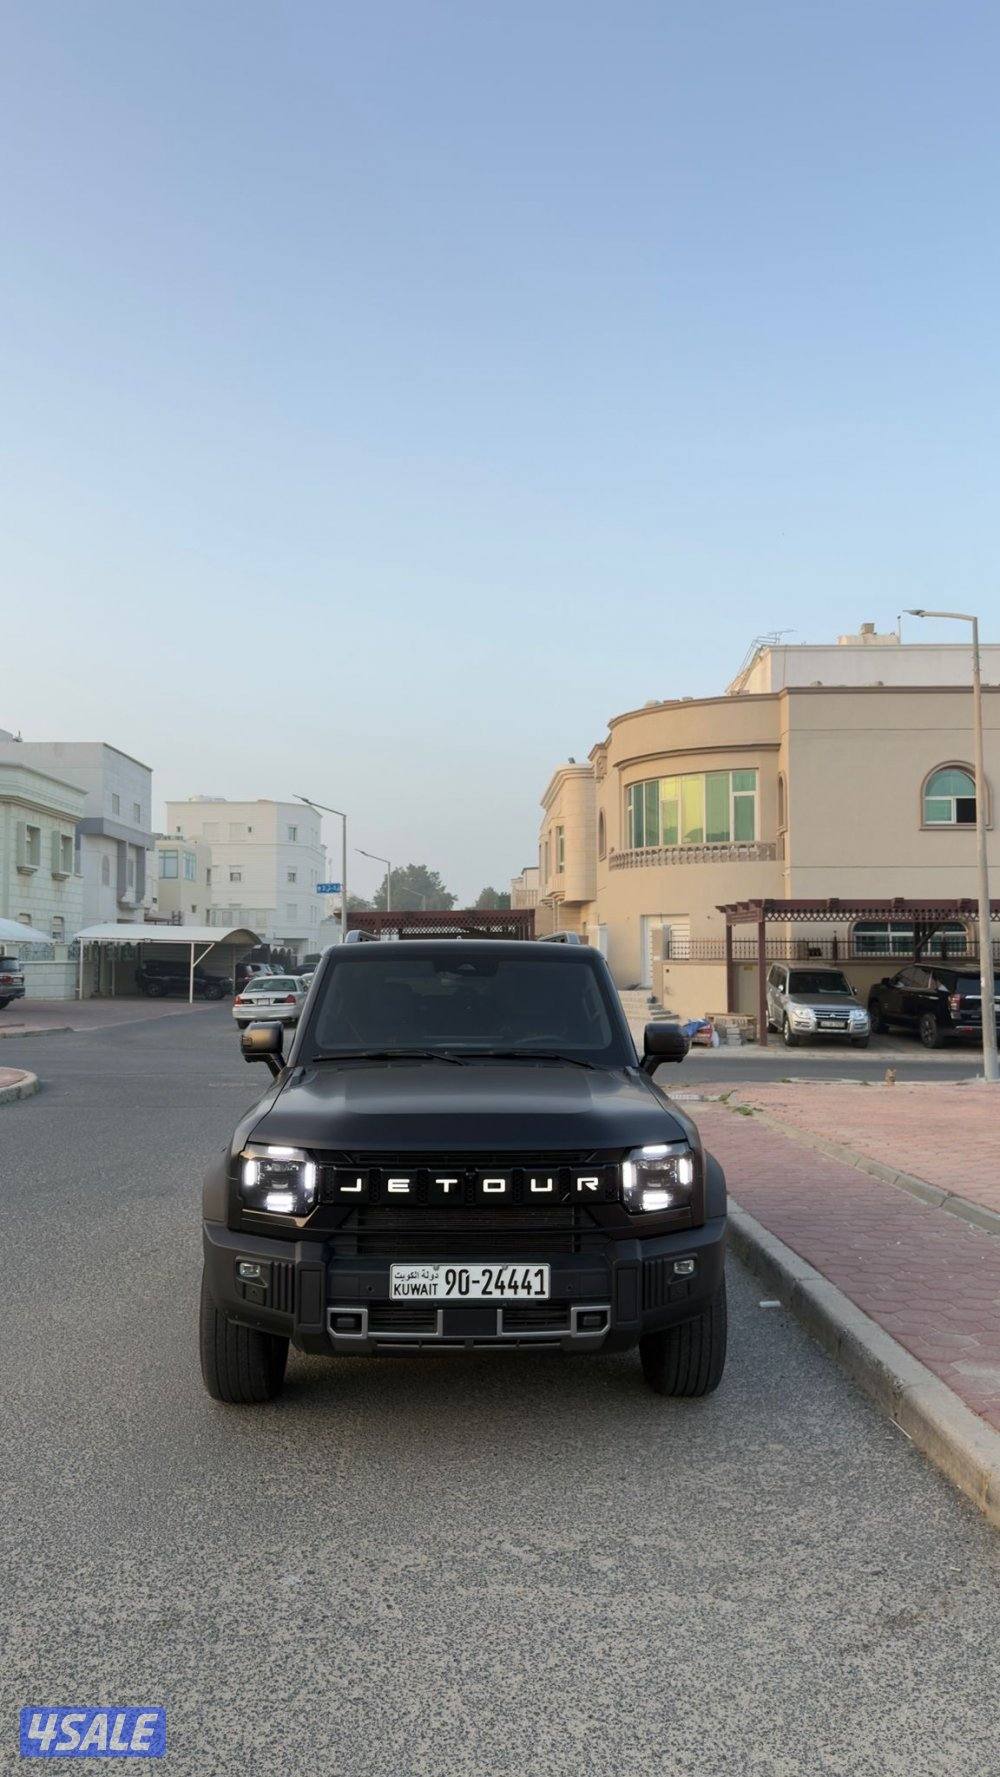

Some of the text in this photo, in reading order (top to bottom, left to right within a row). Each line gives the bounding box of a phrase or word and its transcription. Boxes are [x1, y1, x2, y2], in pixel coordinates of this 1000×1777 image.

[340, 1177, 599, 1193] JETOUR
[394, 1269, 439, 1281] دولة الكويت
[393, 1283, 438, 1296] KUWAIT
[445, 1269, 546, 1296] 90-24441
